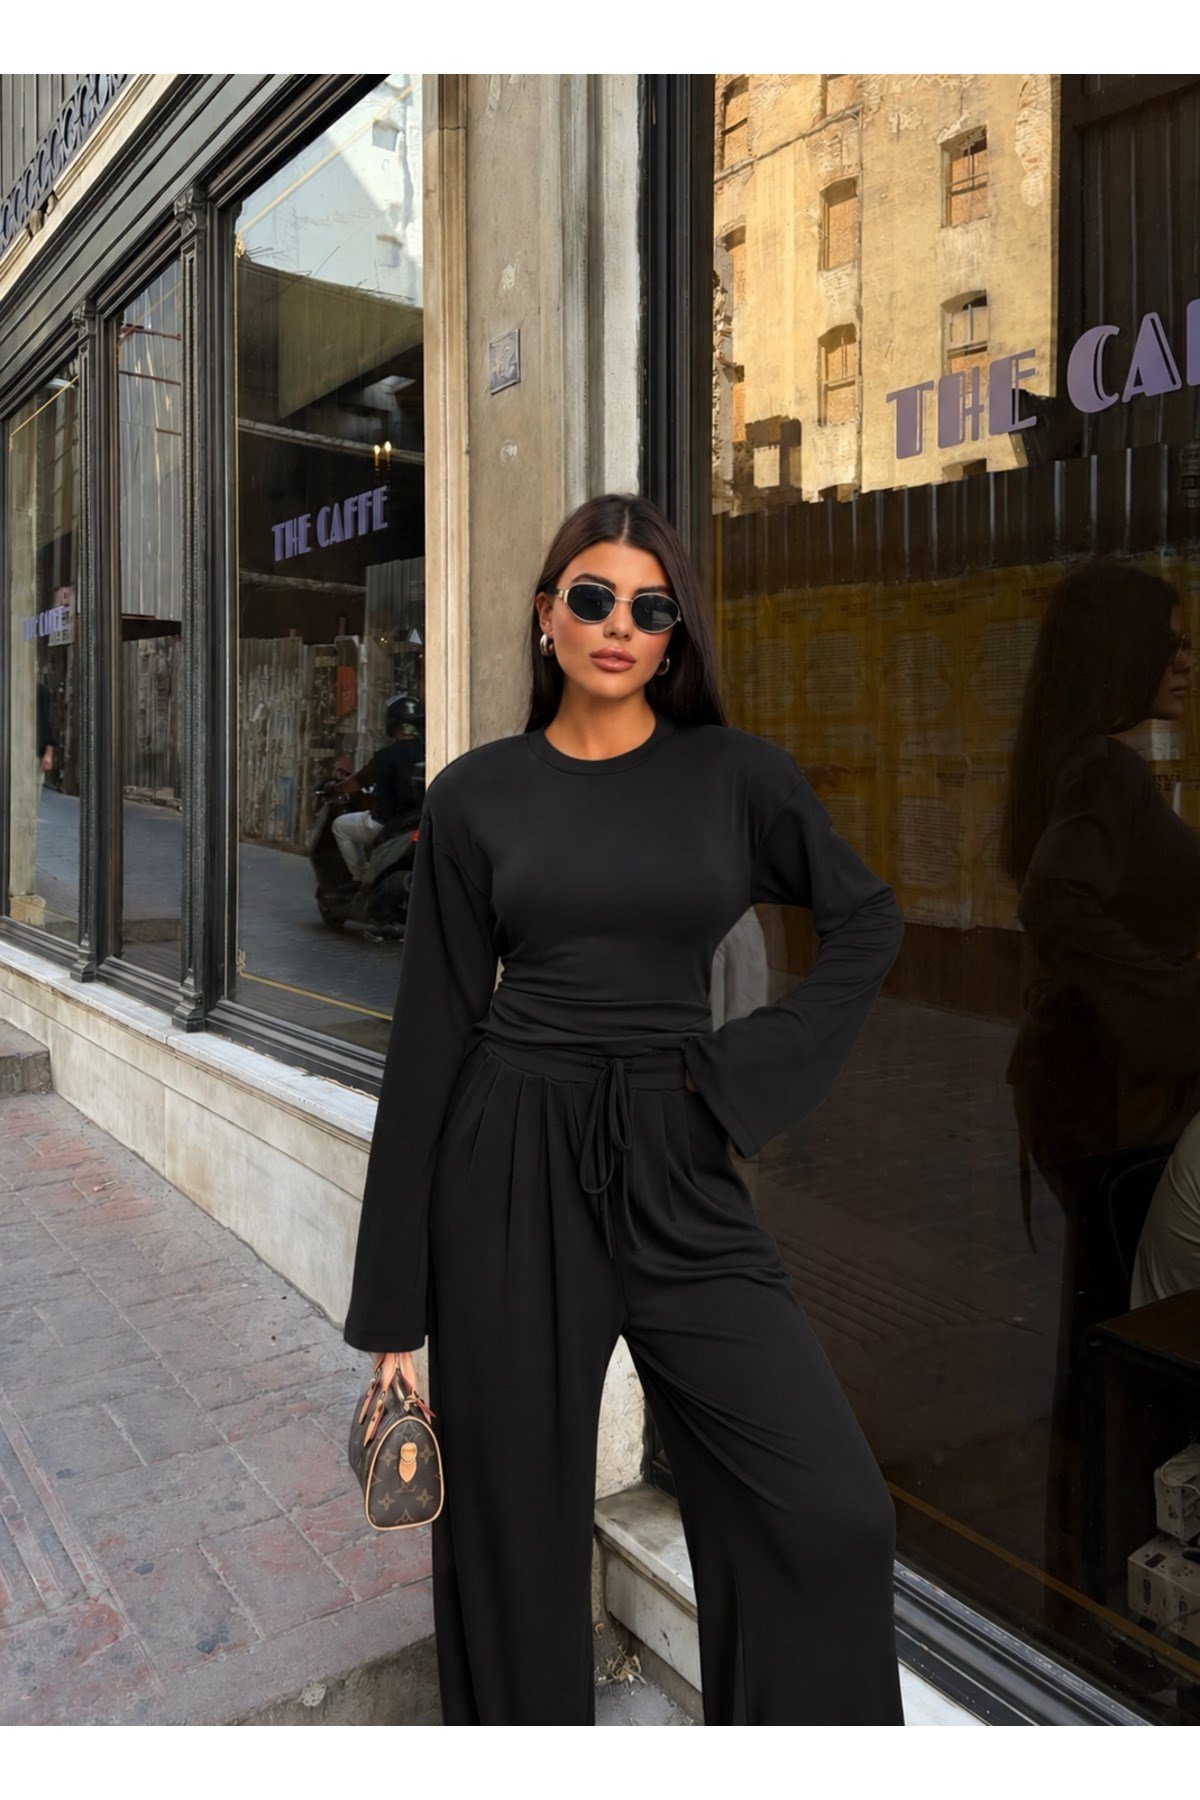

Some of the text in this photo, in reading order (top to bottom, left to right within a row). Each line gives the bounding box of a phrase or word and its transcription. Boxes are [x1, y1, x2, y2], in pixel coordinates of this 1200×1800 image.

[886, 349, 1038, 459] THE
[271, 485, 390, 561] THE CAFFE
